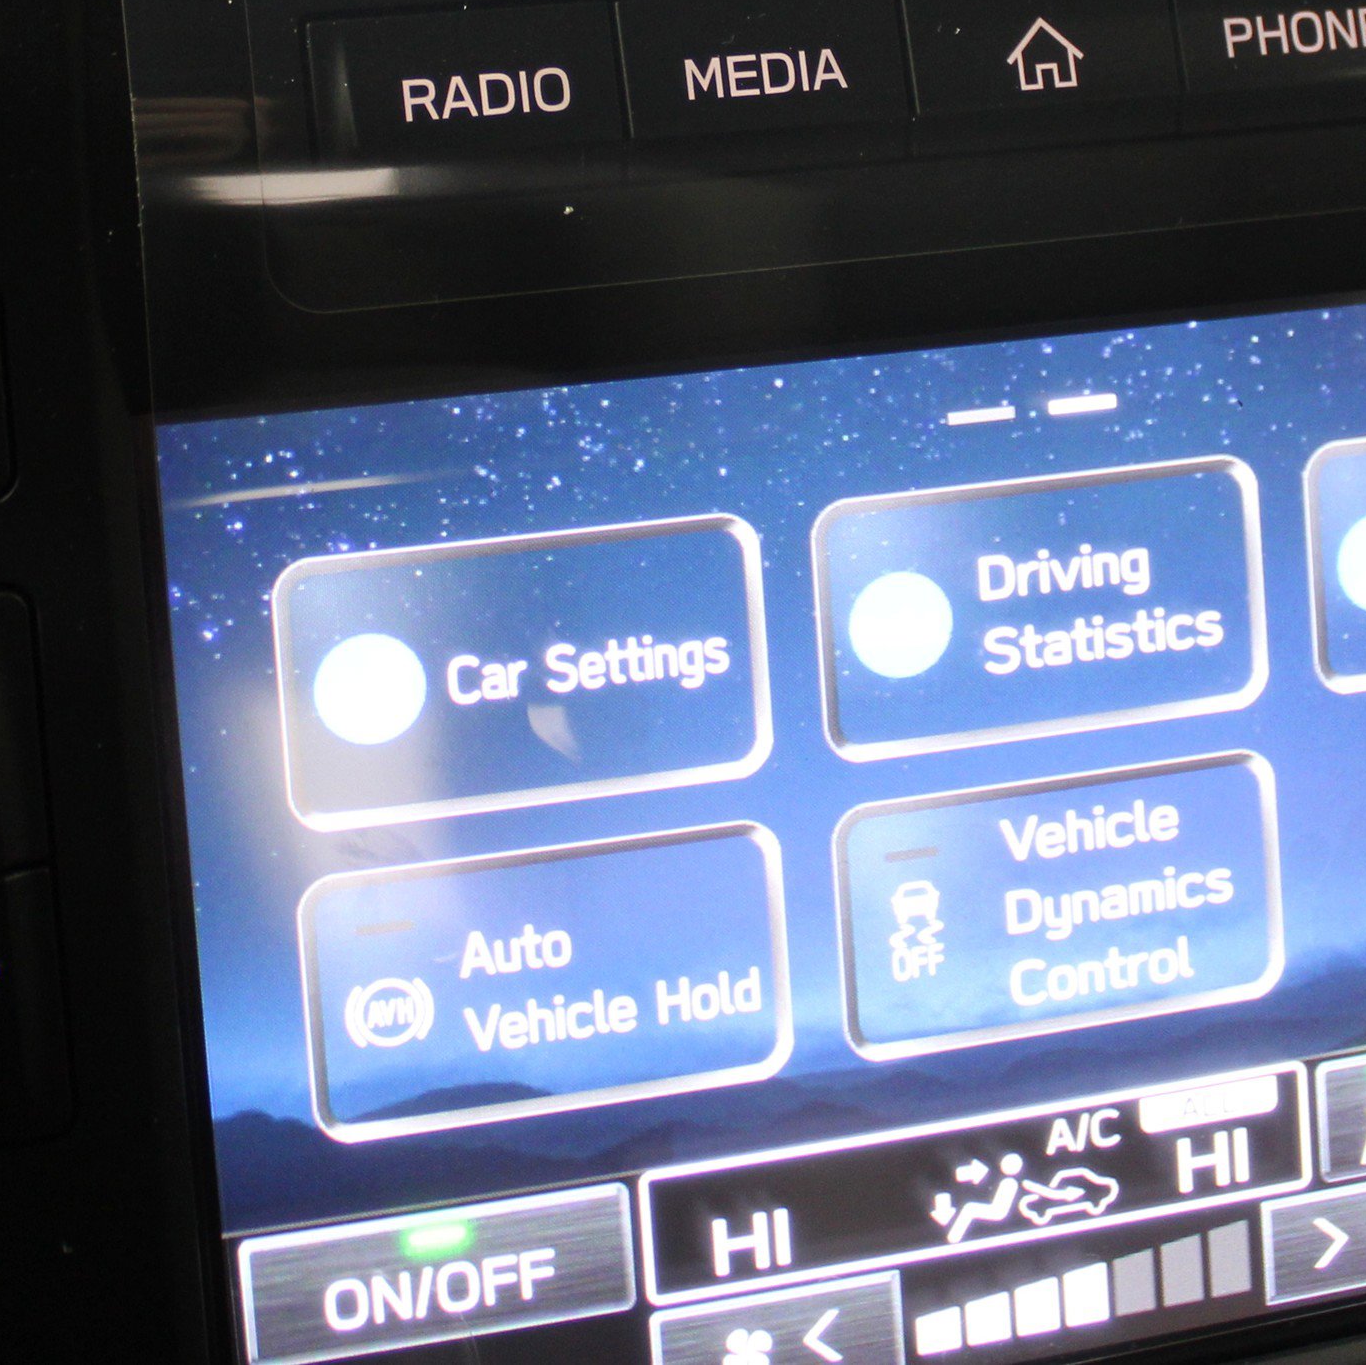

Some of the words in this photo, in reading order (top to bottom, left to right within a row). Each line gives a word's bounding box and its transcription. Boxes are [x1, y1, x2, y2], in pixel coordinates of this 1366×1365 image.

[401, 66, 571, 123] RADIO
[683, 47, 849, 101] MEDIA
[977, 543, 1150, 602] Driving
[446, 654, 528, 706] Car
[545, 634, 730, 693] Settings
[983, 607, 1225, 675] Statistics
[999, 799, 1180, 862] Vehicle
[1005, 866, 1235, 941] Dynamics
[459, 923, 573, 980] Auto
[891, 943, 945, 983] OFF
[1009, 935, 1195, 1007] Control
[366, 997, 414, 1029] AVH
[463, 988, 638, 1052] Vehicle
[655, 966, 762, 1025] Hold
[1045, 1108, 1122, 1156] A/C
[1176, 1127, 1250, 1195] HI
[711, 1207, 793, 1278] HI
[323, 1247, 557, 1332] ON/OFF
